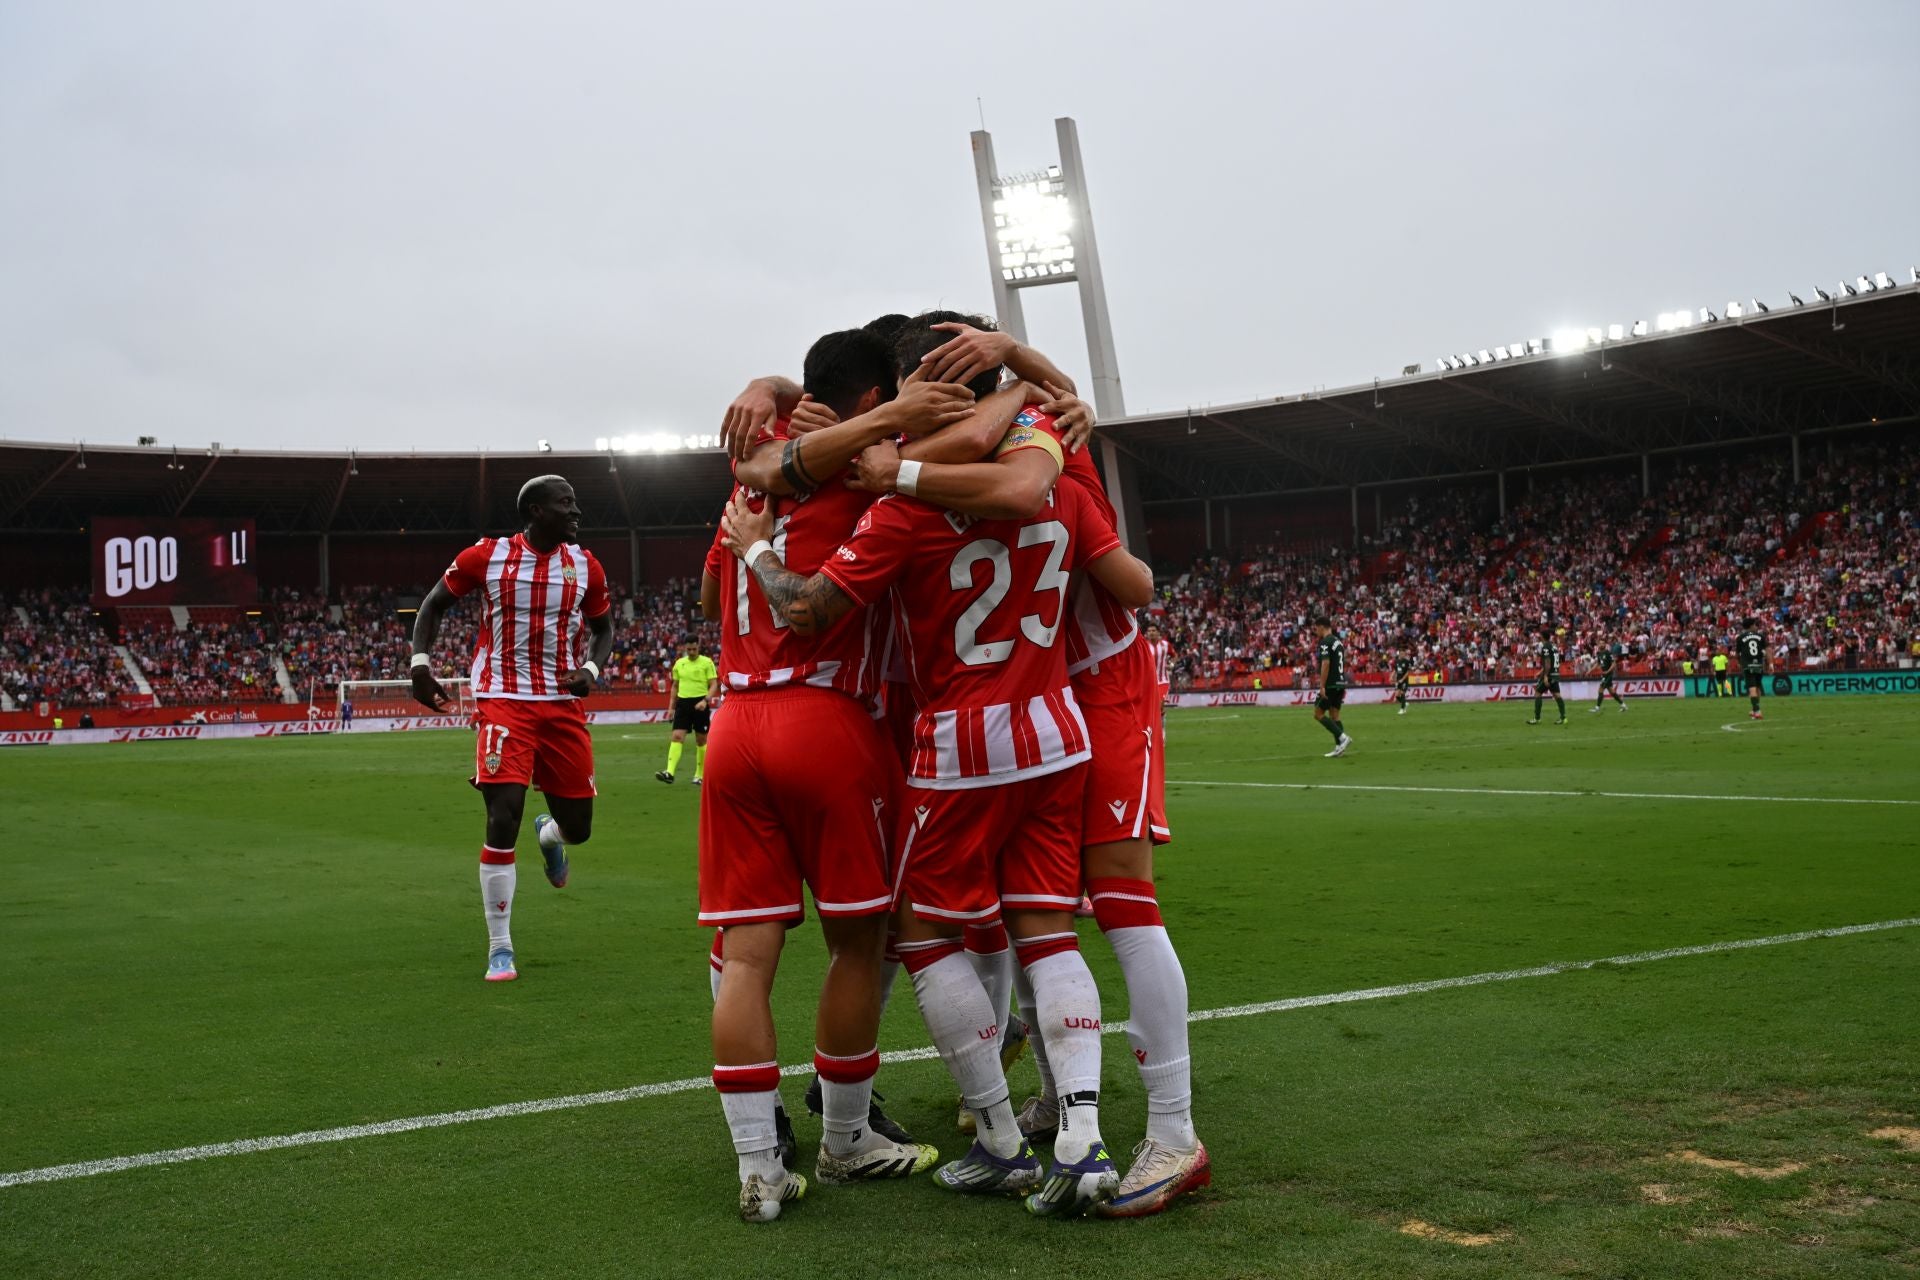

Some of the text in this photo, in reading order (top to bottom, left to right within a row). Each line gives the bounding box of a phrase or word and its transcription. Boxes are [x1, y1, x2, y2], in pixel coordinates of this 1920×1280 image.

[105, 536, 177, 597] GOO
[950, 520, 1069, 666] 23
[1749, 640, 1758, 656] 8
[1338, 652, 1344, 673] 3
[1623, 680, 1682, 693] CANO
[1799, 675, 1920, 692] HYPERMOTIO
[1222, 693, 1259, 703] CANO
[0, 731, 54, 743] ANO
[137, 725, 202, 738] CANO
[485, 724, 509, 754] 17
[1064, 1017, 1100, 1031] UDA
